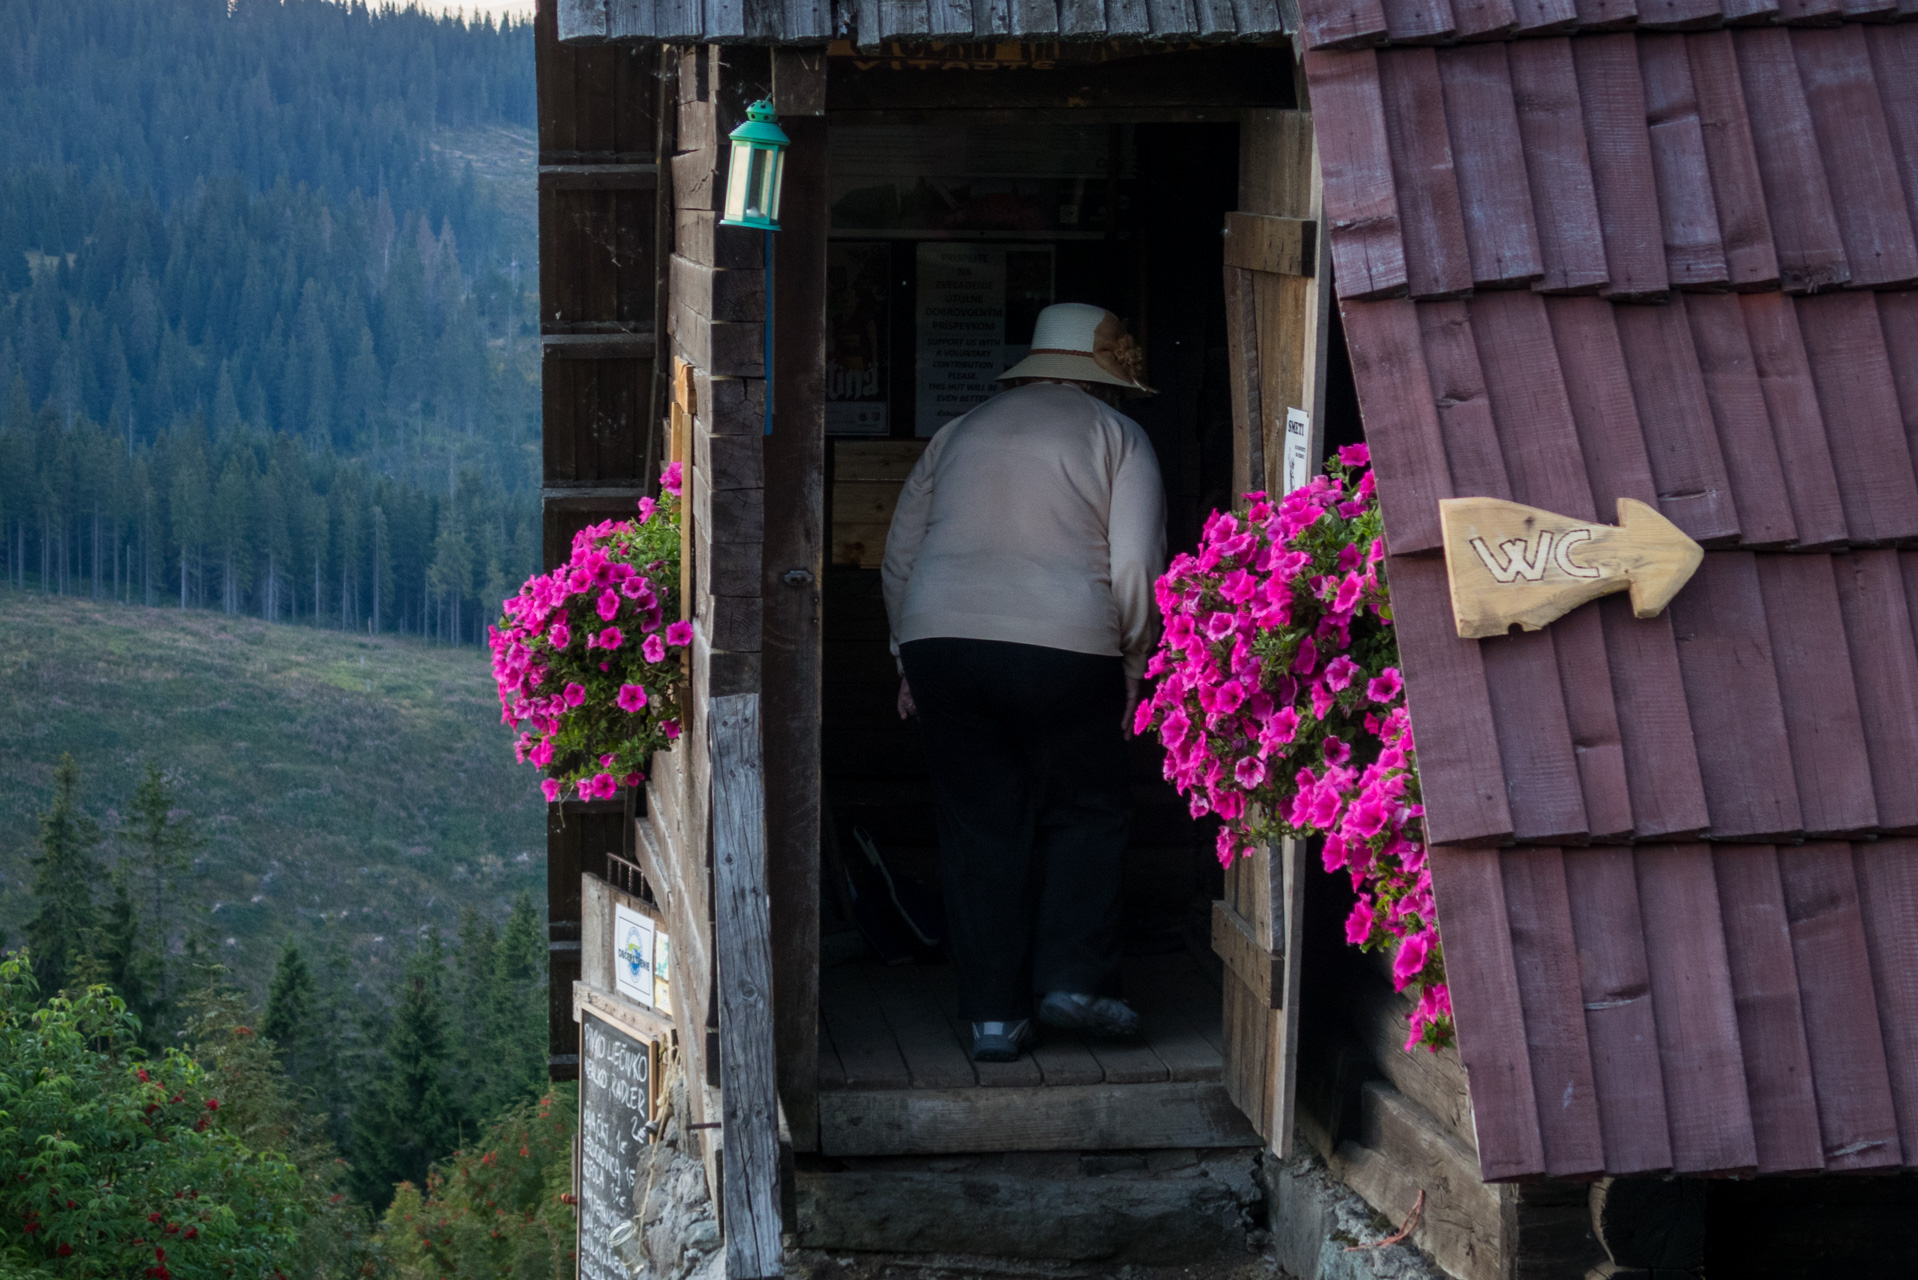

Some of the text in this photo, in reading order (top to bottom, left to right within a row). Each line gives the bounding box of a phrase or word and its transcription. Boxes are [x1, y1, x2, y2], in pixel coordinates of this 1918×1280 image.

[957, 268, 972, 276] NA
[927, 337, 1001, 347] SUPPORT US WITH
[935, 349, 992, 358] A VOLUNTARY
[932, 360, 994, 369] CONTRIBUTION
[928, 383, 946, 391] THIS
[937, 394, 958, 402] EVEN
[1287, 419, 1305, 437] SMETI
[1469, 529, 1600, 584] WC
